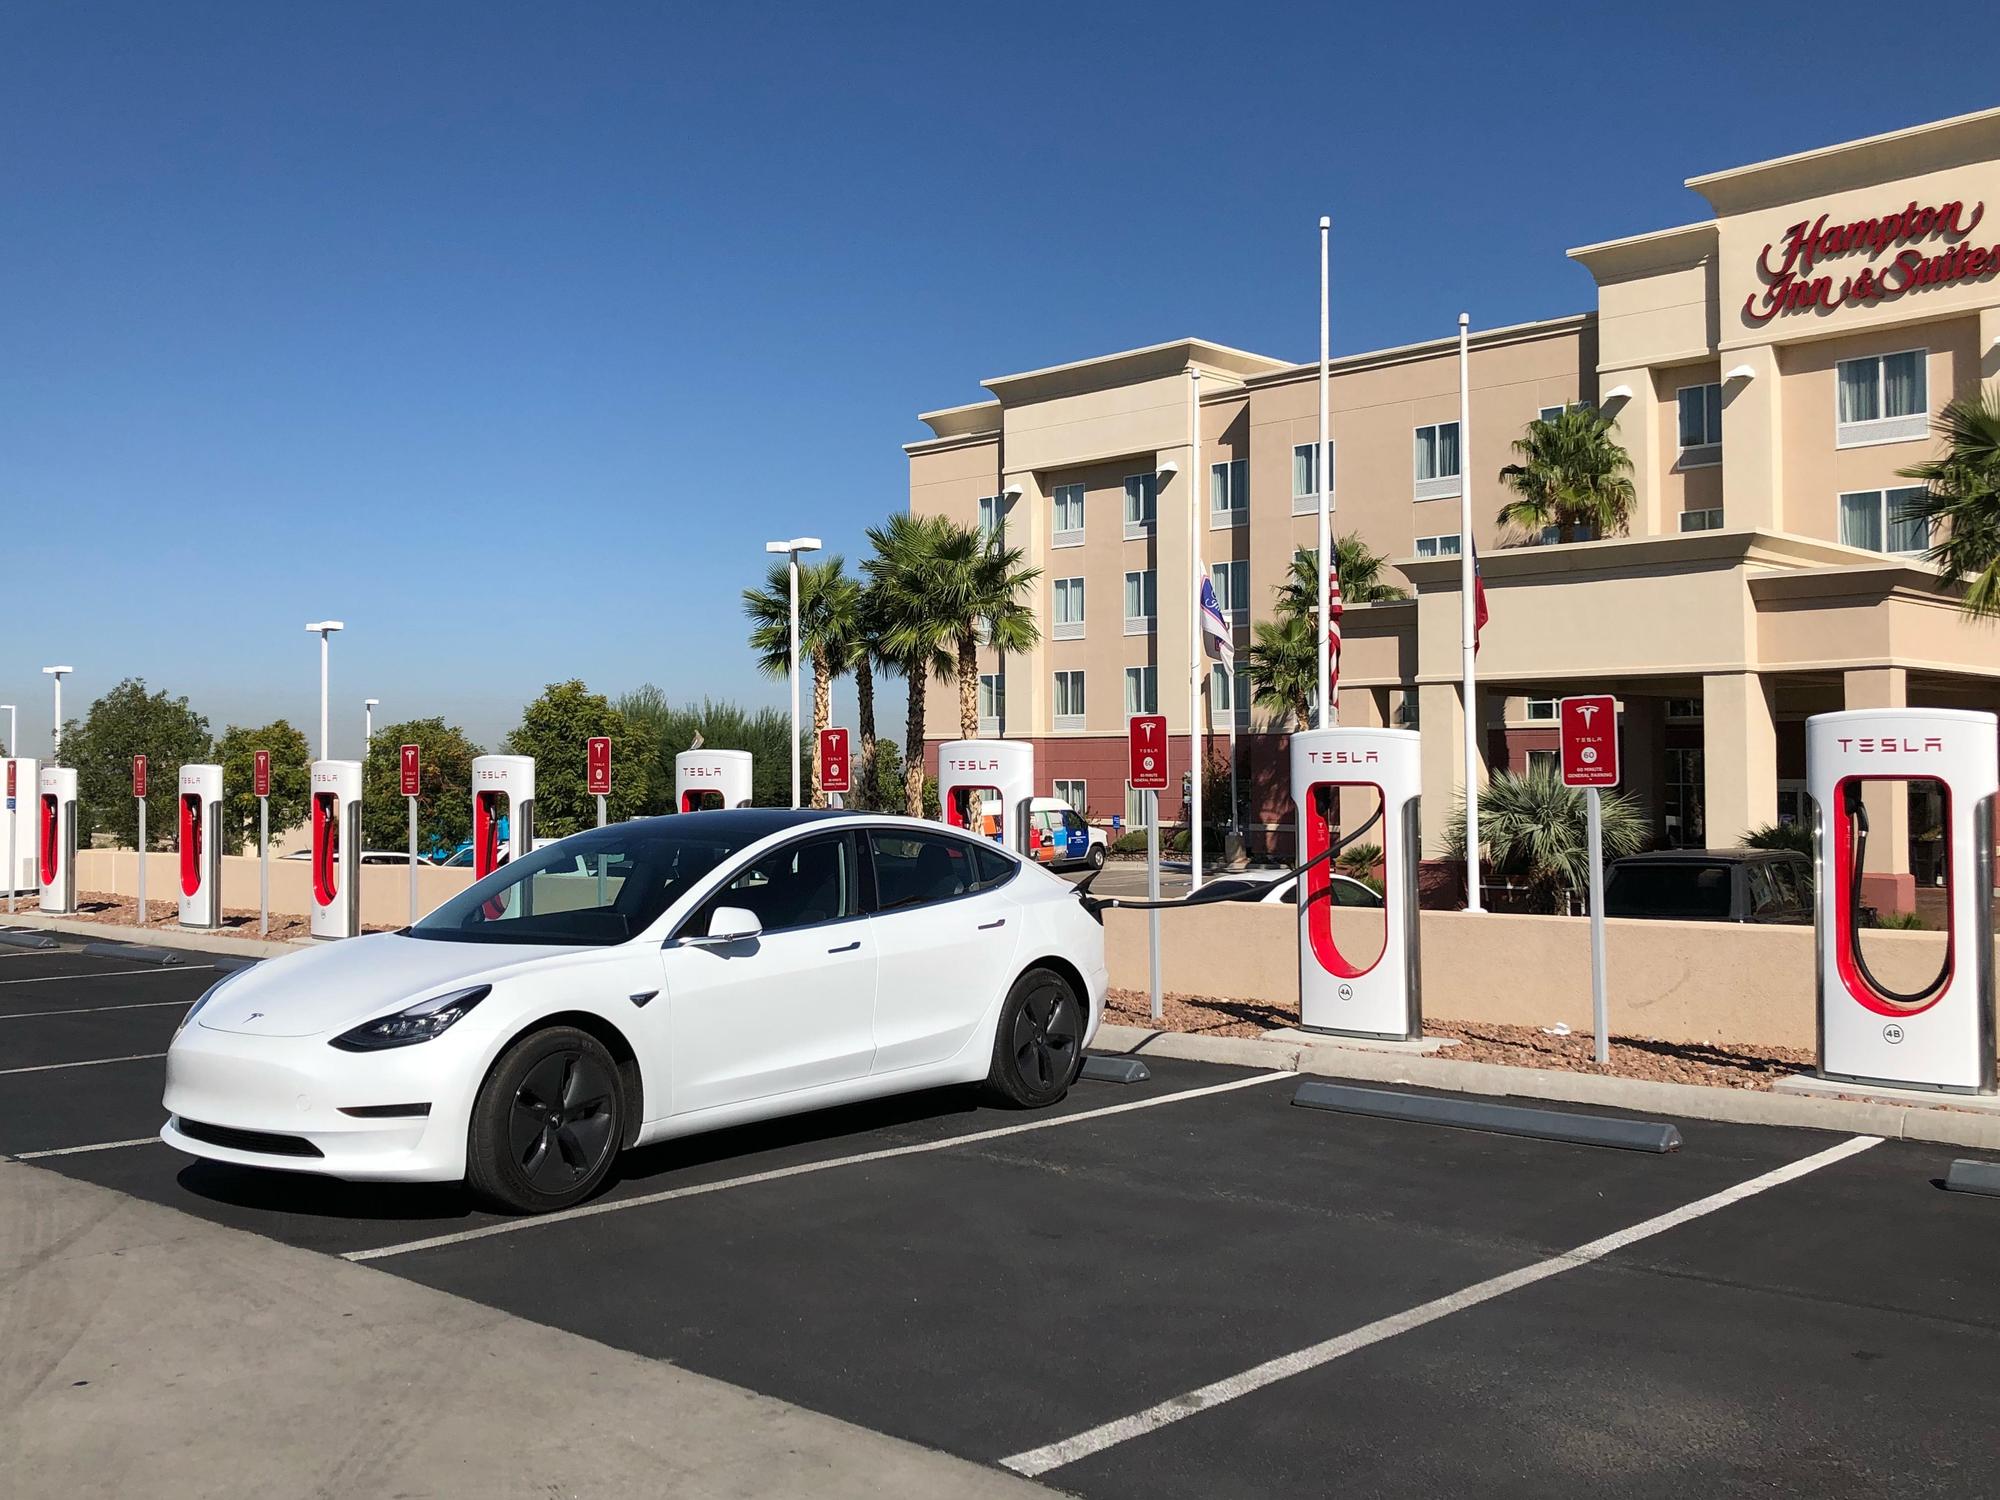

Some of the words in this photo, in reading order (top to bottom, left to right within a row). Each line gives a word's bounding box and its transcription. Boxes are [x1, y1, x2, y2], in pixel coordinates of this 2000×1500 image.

[1763, 200, 1985, 276] Hampton
[1747, 271, 1850, 321] Inn
[1851, 266, 1882, 300] &
[1880, 240, 2000, 293] Suites
[1837, 737, 1943, 753] TESLA
[1308, 751, 1379, 764] TESLA
[1583, 751, 1595, 759] 60
[948, 760, 999, 770] TESLA
[476, 770, 508, 779] TESLA
[683, 767, 722, 777] TESLA
[313, 774, 338, 782] TESLA
[1340, 988, 1351, 996] 4A
[1885, 1029, 1901, 1038] 4B
